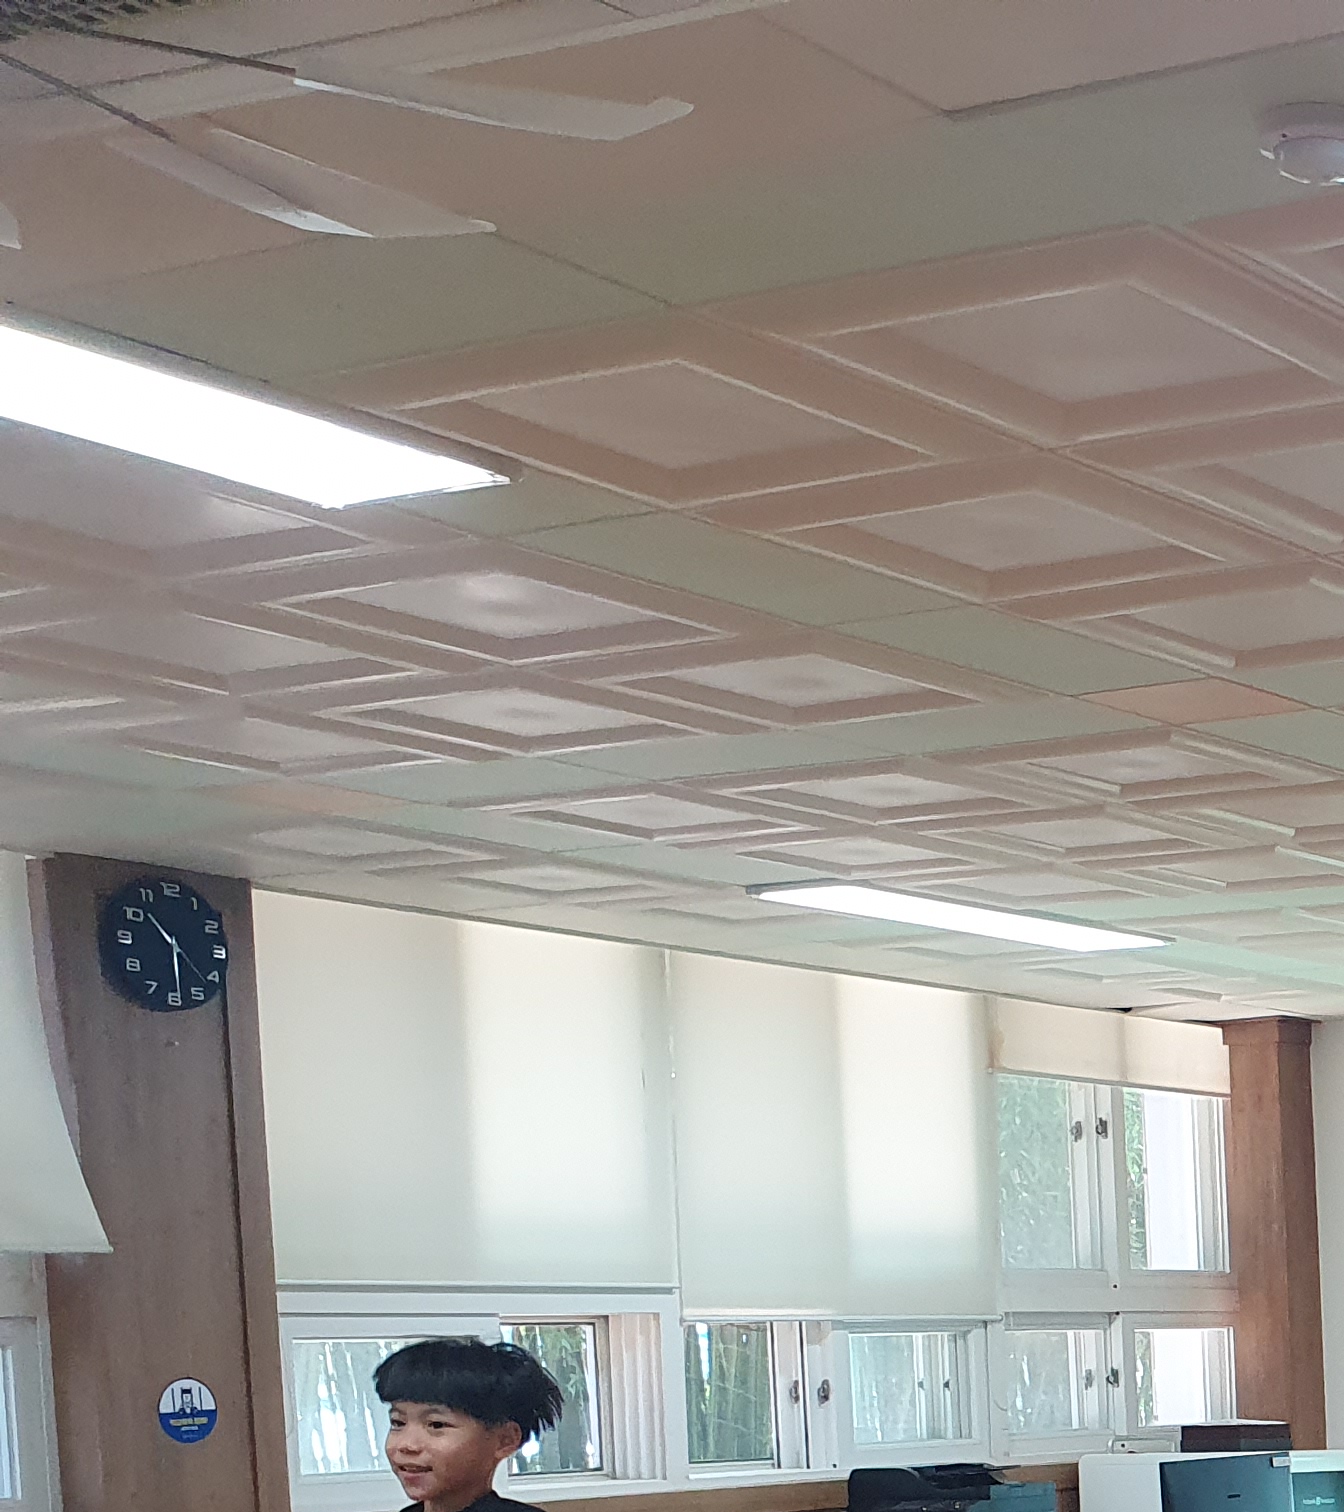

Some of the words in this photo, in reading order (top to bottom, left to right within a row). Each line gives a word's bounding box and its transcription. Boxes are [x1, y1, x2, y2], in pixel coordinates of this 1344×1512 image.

[140, 888, 153, 902] 11
[160, 882, 181, 897] 12
[191, 897, 198, 910] 1
[123, 906, 144, 922] 10
[205, 920, 219, 934] 2
[117, 930, 132, 944] 9
[213, 945, 226, 959] 3
[126, 958, 140, 972] 8
[206, 971, 219, 983] 4
[145, 981, 158, 994] 7
[191, 987, 204, 1000] 5
[167, 992, 181, 1006] 6
